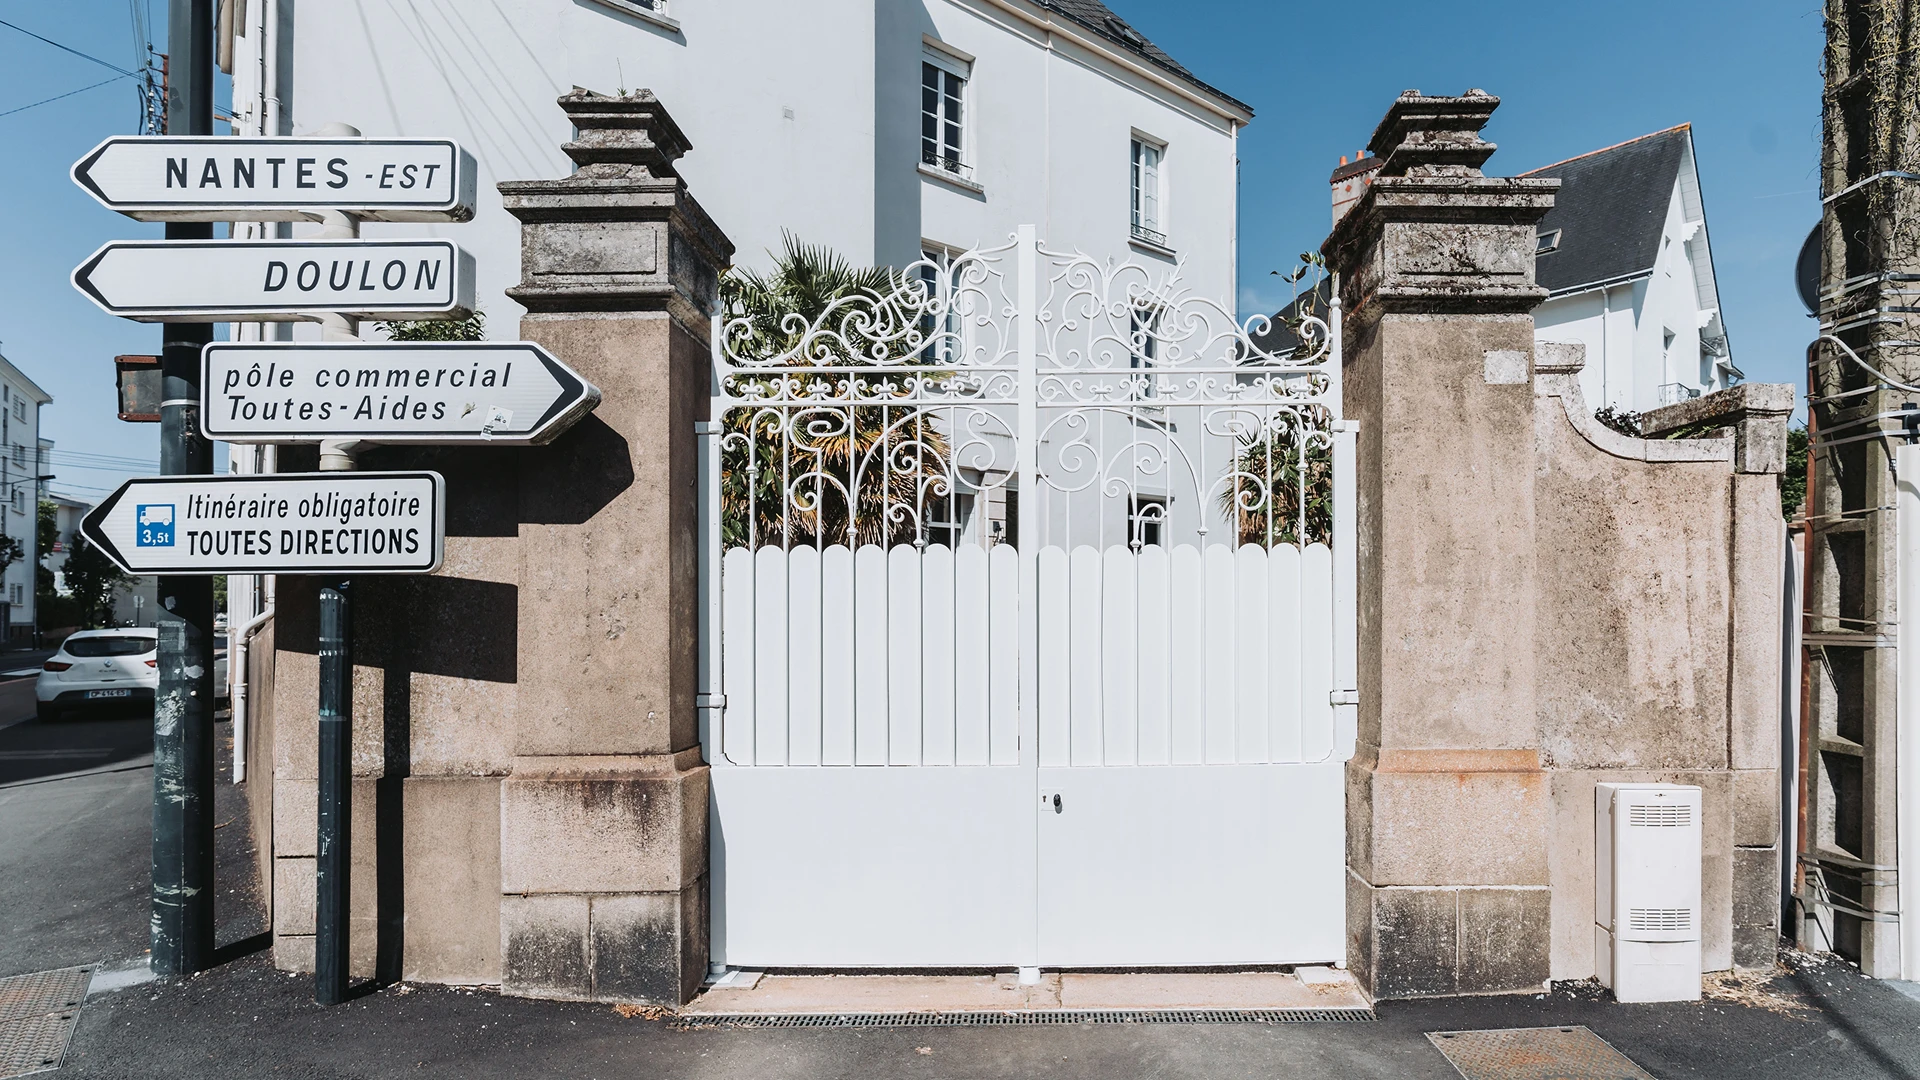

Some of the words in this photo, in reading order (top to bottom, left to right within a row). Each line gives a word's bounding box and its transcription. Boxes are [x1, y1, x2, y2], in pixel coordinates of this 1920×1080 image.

[166, 157, 349, 189] NANTES
[263, 260, 441, 292] DOULON
[223, 362, 295, 394] pôle
[315, 362, 512, 388] commercial
[227, 394, 446, 421] Toutes-Aides
[186, 492, 289, 520] Itinéraire
[298, 490, 420, 525] obligatoire
[142, 529, 169, 546] 3,5t
[186, 529, 272, 556] TOUTES
[280, 527, 419, 555] DIRECTIONS
